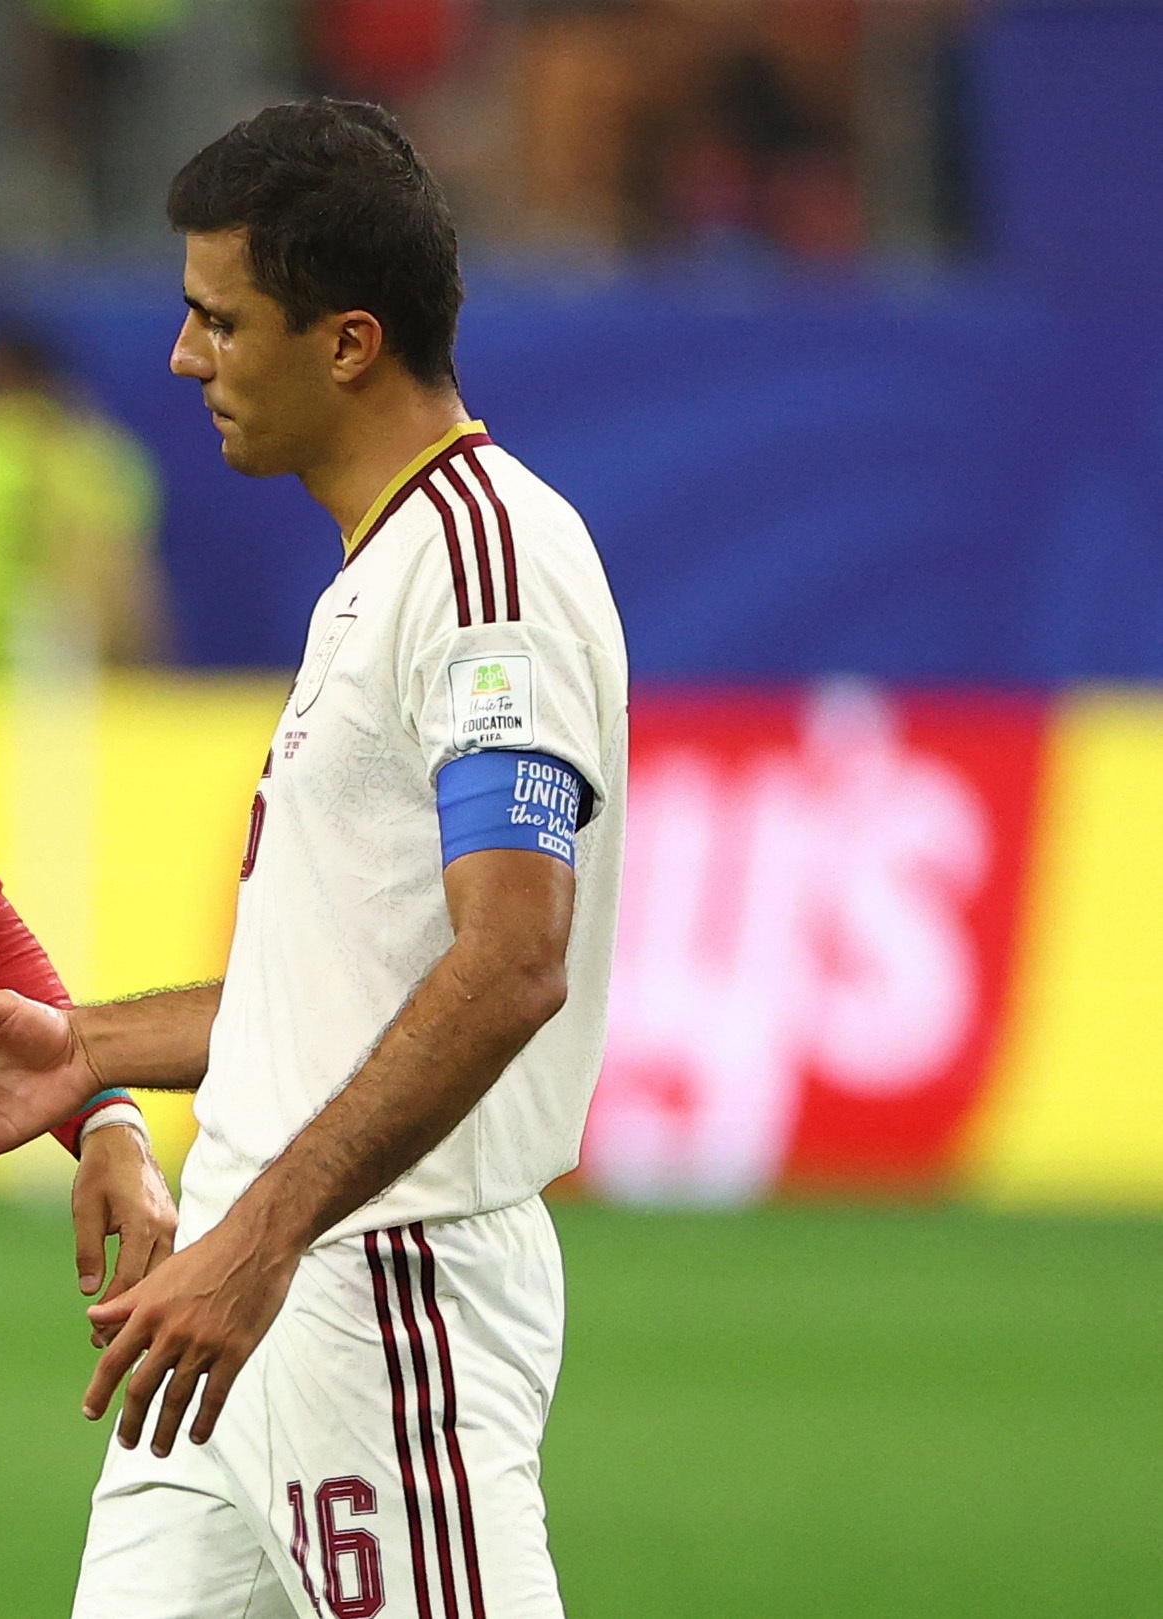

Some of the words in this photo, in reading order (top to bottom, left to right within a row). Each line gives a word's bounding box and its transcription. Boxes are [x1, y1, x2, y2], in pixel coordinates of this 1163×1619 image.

[496, 695, 513, 712] For
[462, 715, 523, 734] EDUCATION
[479, 732, 503, 742] FIFA
[513, 777, 579, 824] UNITE
[506, 803, 545, 826] the
[540, 834, 570, 858] FIFA
[286, 1475, 386, 1619] 16
